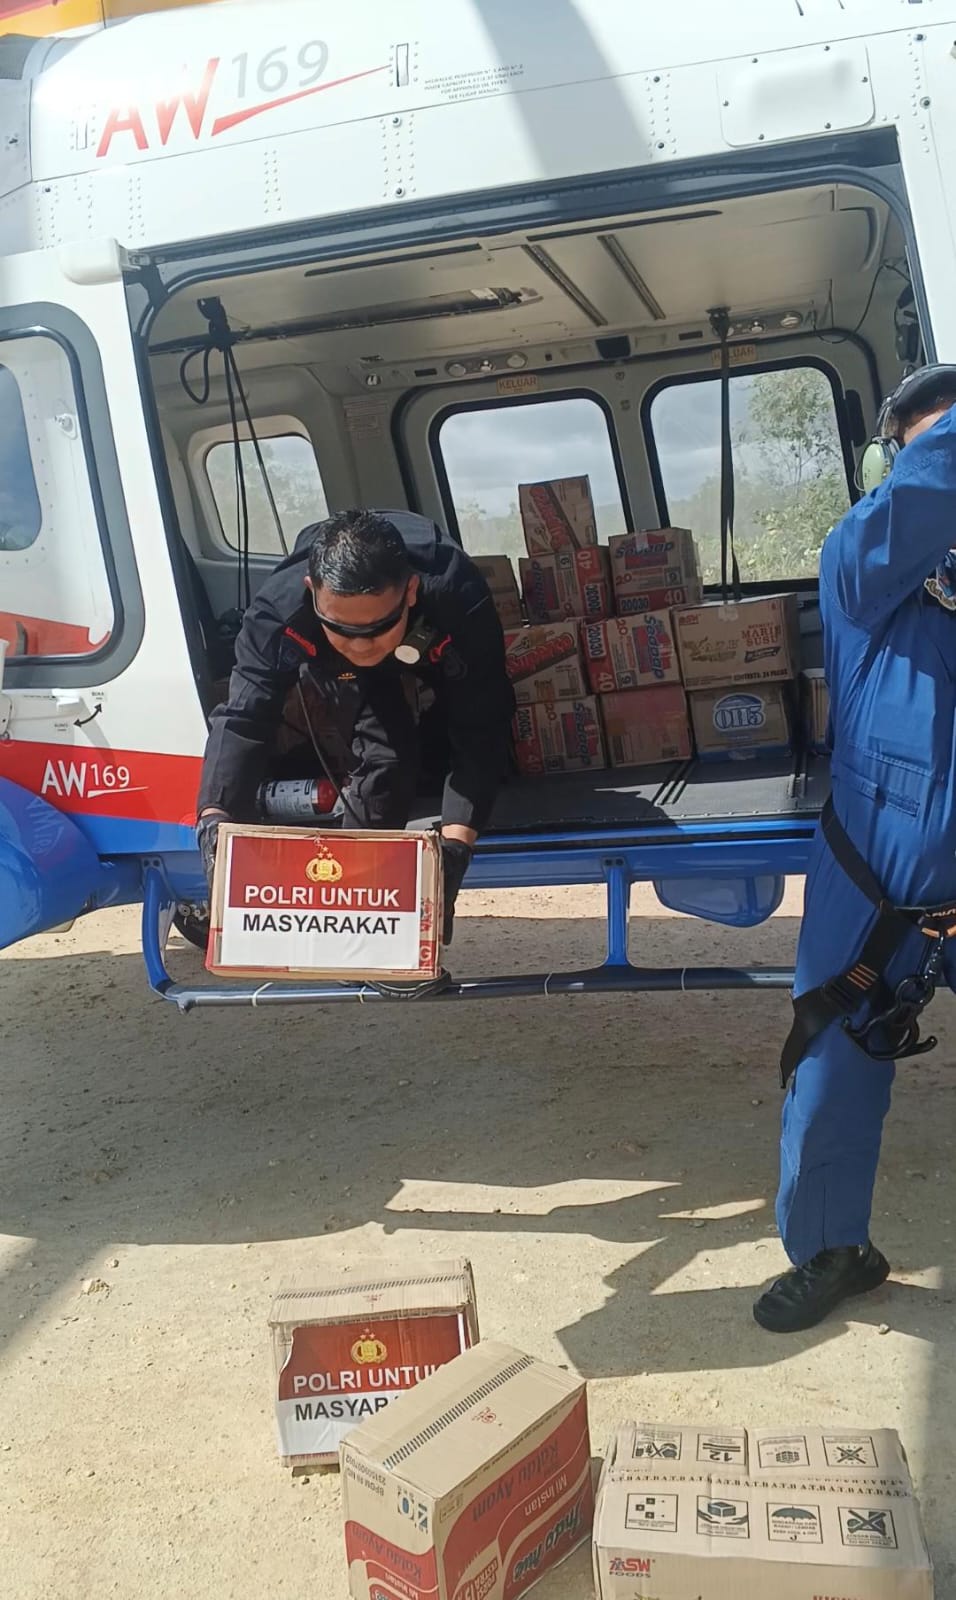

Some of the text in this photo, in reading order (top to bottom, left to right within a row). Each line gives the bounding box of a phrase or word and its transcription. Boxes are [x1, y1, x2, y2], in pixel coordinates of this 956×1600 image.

[96, 39, 329, 157] AW169
[41, 759, 130, 799] AW169
[244, 885, 400, 907] POLRI UNTUK
[242, 914, 400, 935] MASYARAKAT
[293, 1370, 362, 1394] POLRI
[295, 1395, 399, 1422] MASYAR
[709, 1450, 733, 1462] 12
[470, 1477, 515, 1522] Ayam
[524, 1485, 558, 1517] Instan
[609, 1571, 652, 1579] FOODS
